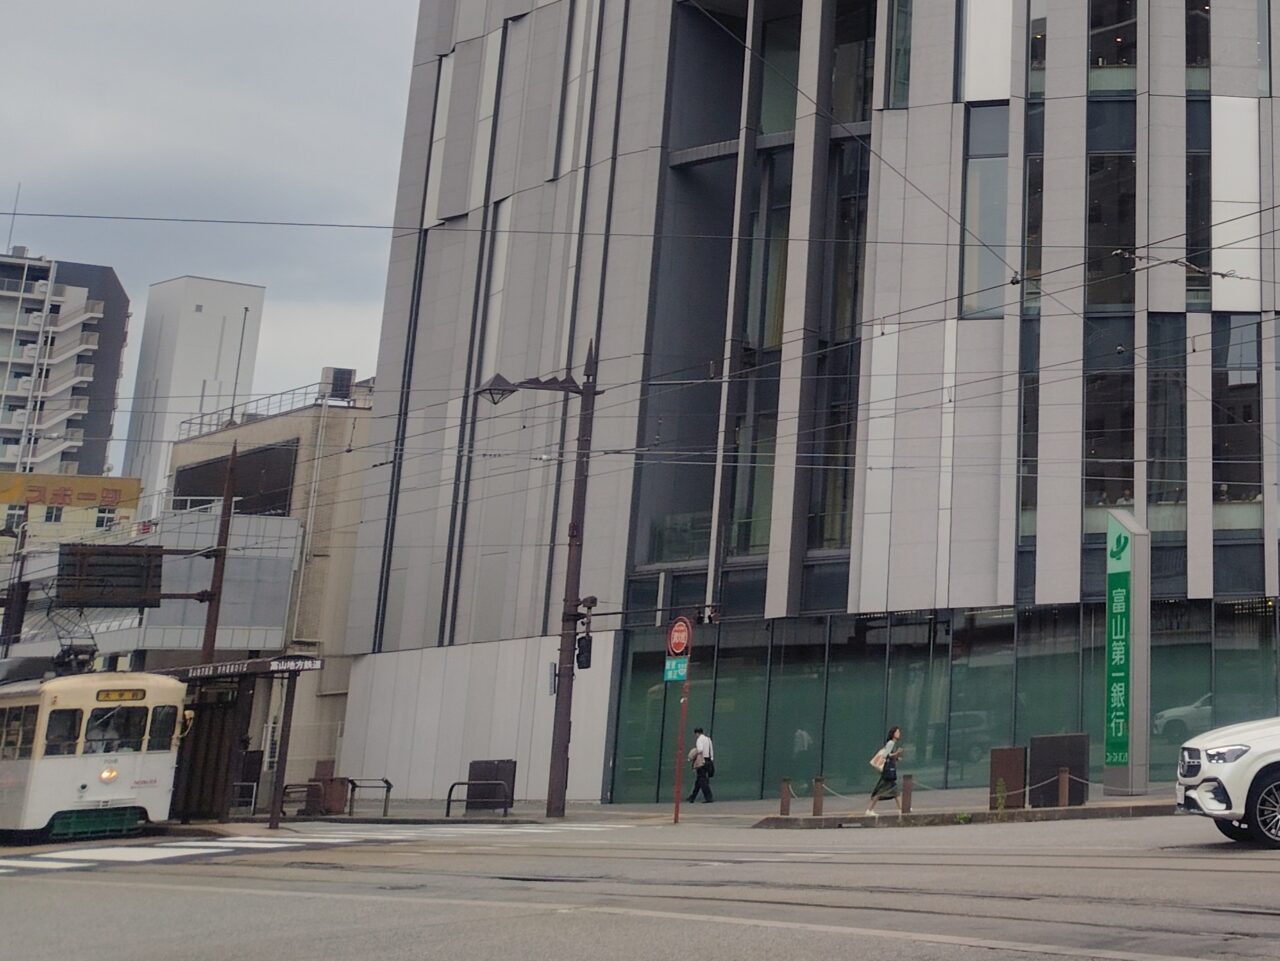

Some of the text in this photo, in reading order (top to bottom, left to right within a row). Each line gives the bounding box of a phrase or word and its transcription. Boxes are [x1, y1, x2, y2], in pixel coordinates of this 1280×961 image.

[1110, 587, 1126, 737] 富山第一銀行
